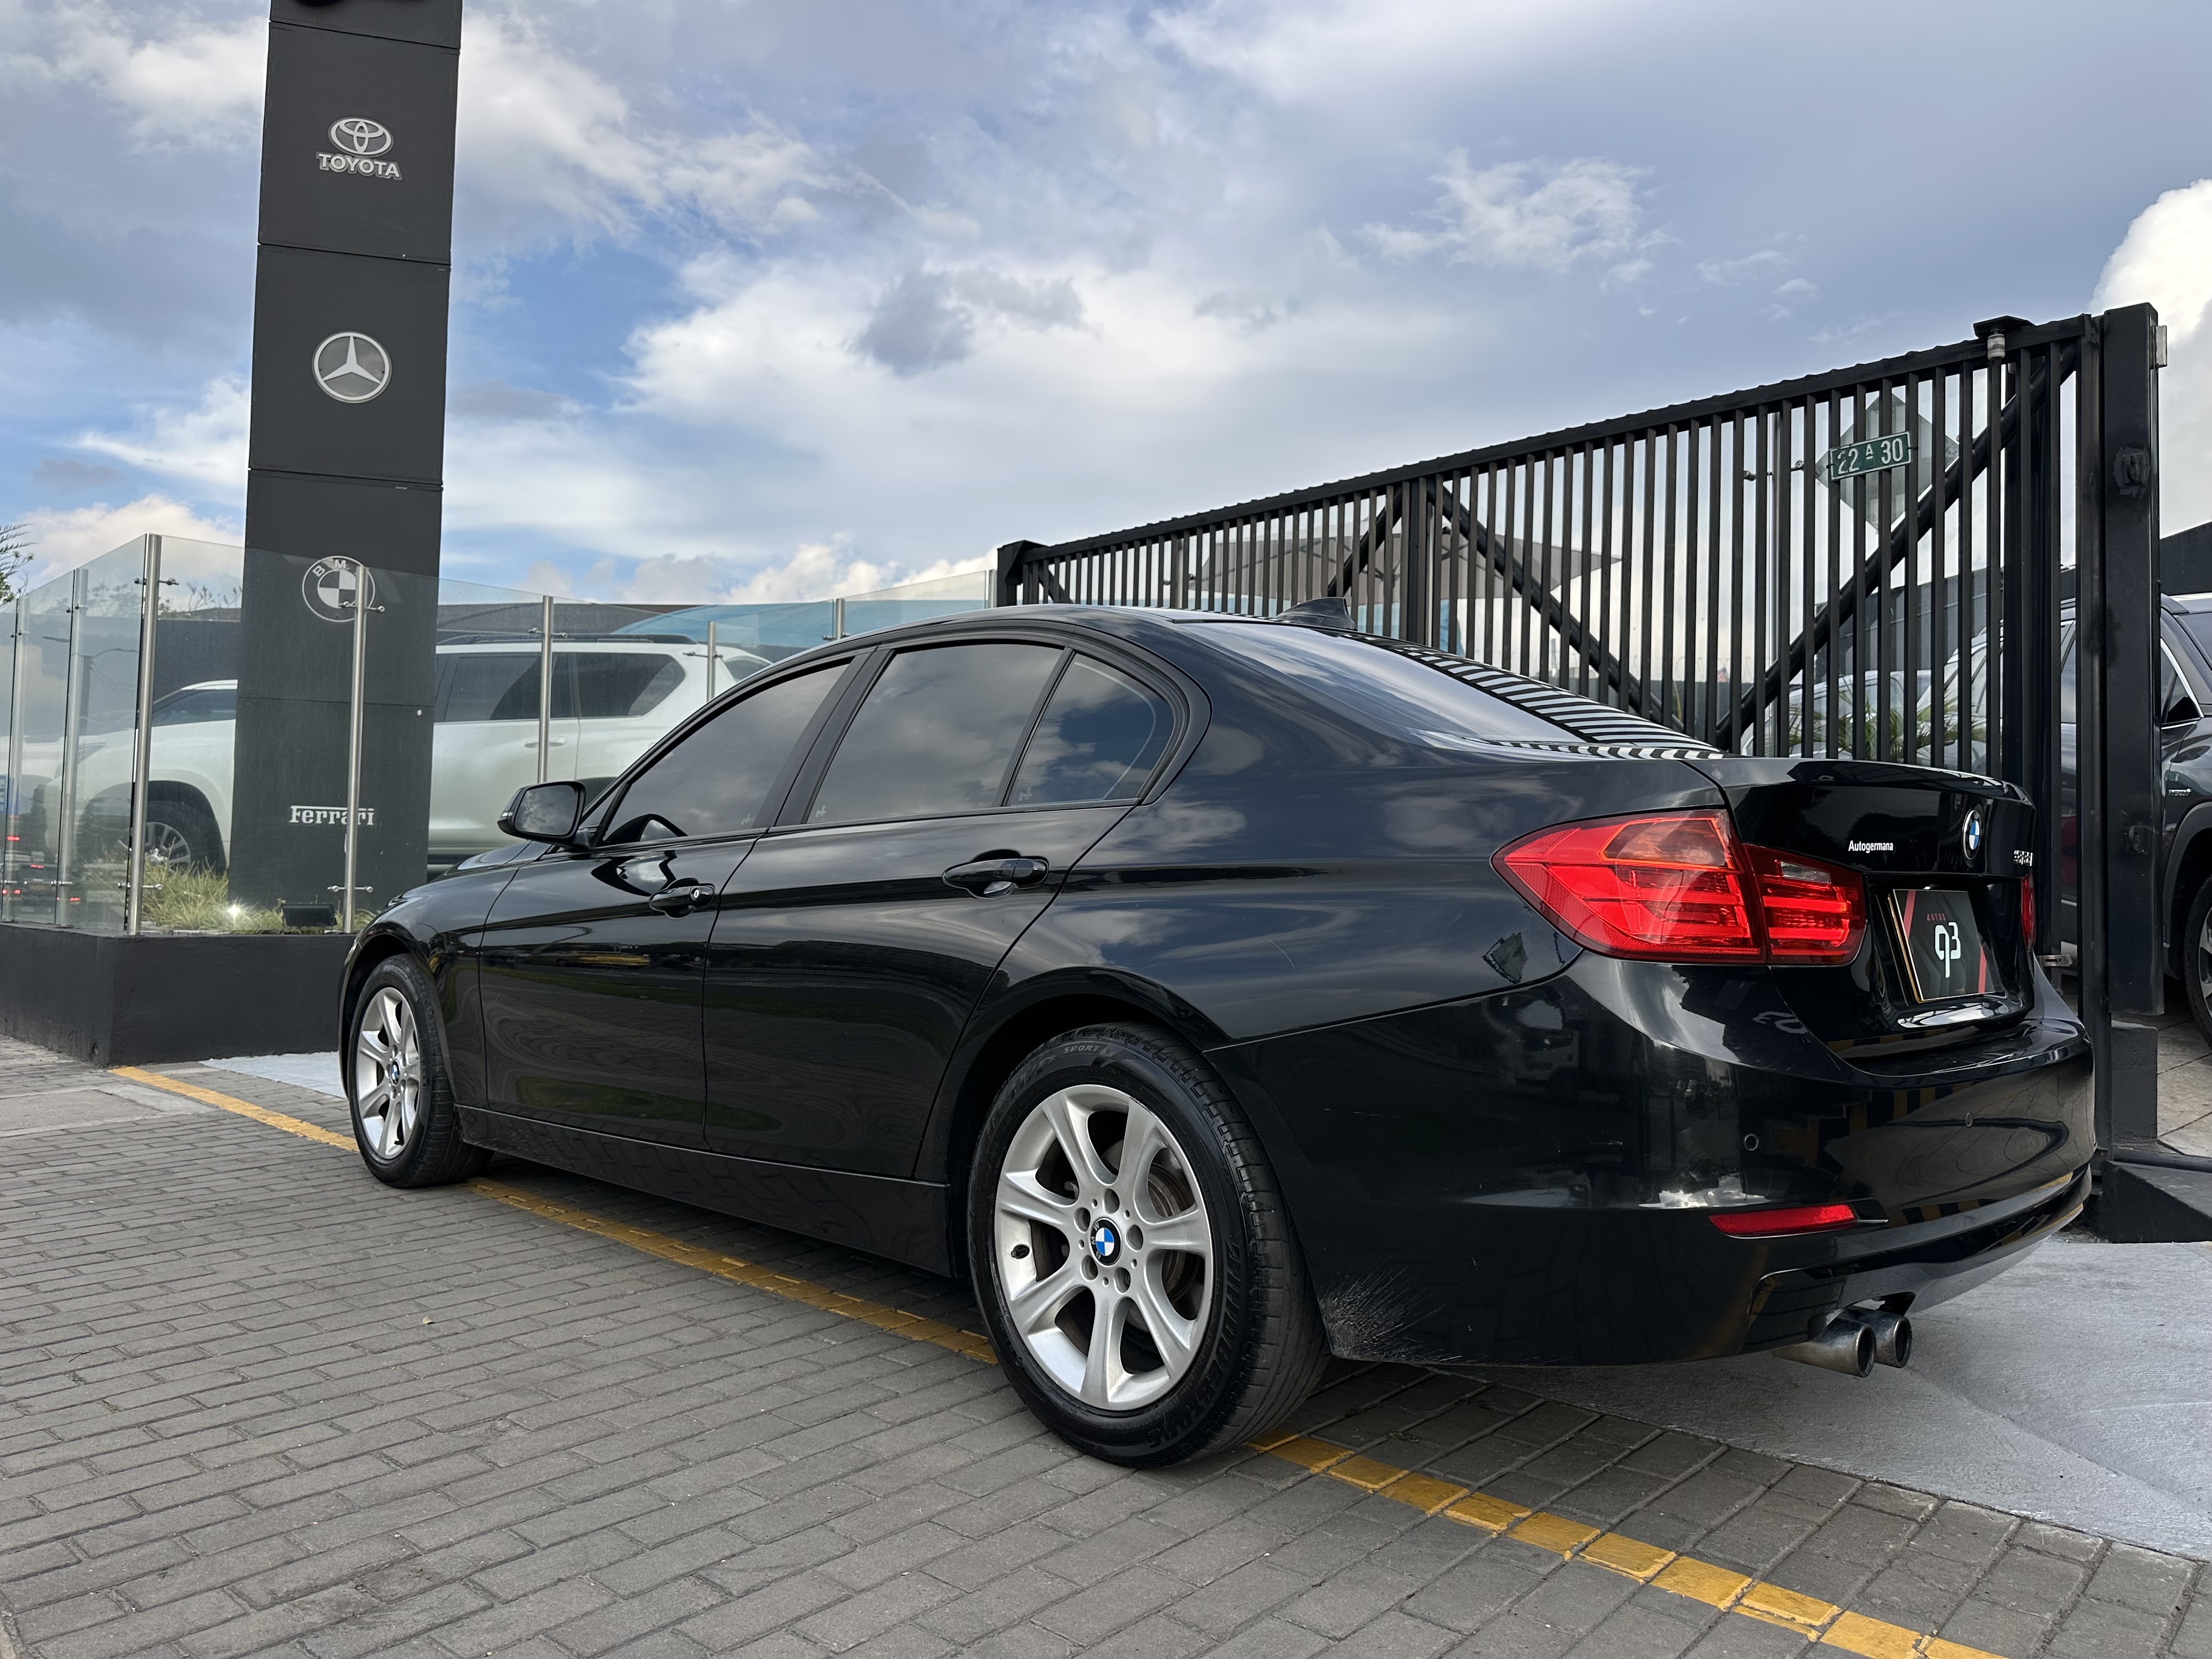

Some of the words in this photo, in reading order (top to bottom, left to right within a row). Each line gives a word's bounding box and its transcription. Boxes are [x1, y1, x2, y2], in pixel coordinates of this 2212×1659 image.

[318, 153, 400, 177] TOYOTA
[1837, 448, 1859, 475] 22
[1865, 443, 1874, 460] A
[1880, 438, 1904, 464] 30
[312, 559, 356, 578] BM
[1848, 840, 1894, 854] Autogermana
[1926, 912, 1946, 922] AUTOS
[1063, 1045, 1102, 1054] SPORT
[1091, 1222, 1102, 1261] BMW
